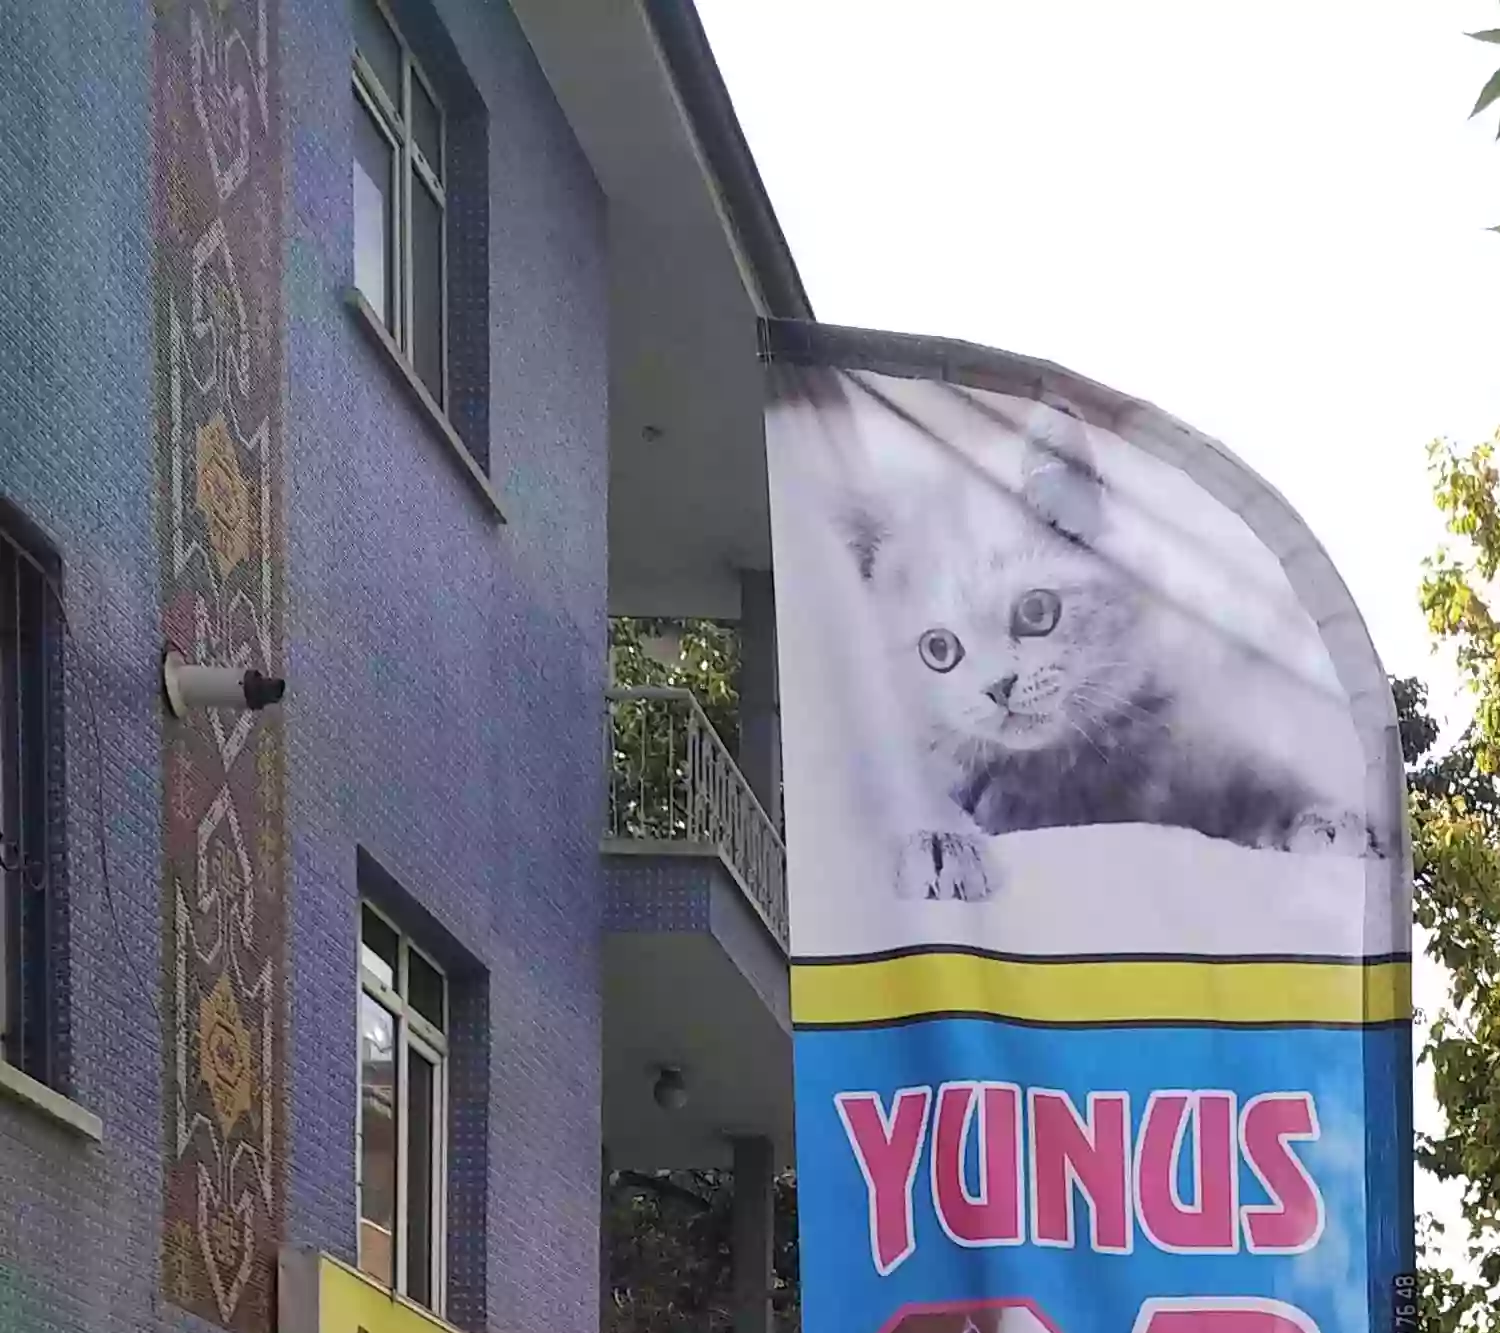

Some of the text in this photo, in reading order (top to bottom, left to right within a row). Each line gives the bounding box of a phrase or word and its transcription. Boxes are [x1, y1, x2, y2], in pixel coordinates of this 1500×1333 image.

[834, 1081, 1326, 1276] YUNUS
[1395, 1275, 1415, 1299] 48
[1396, 1304, 1417, 1327] 76
